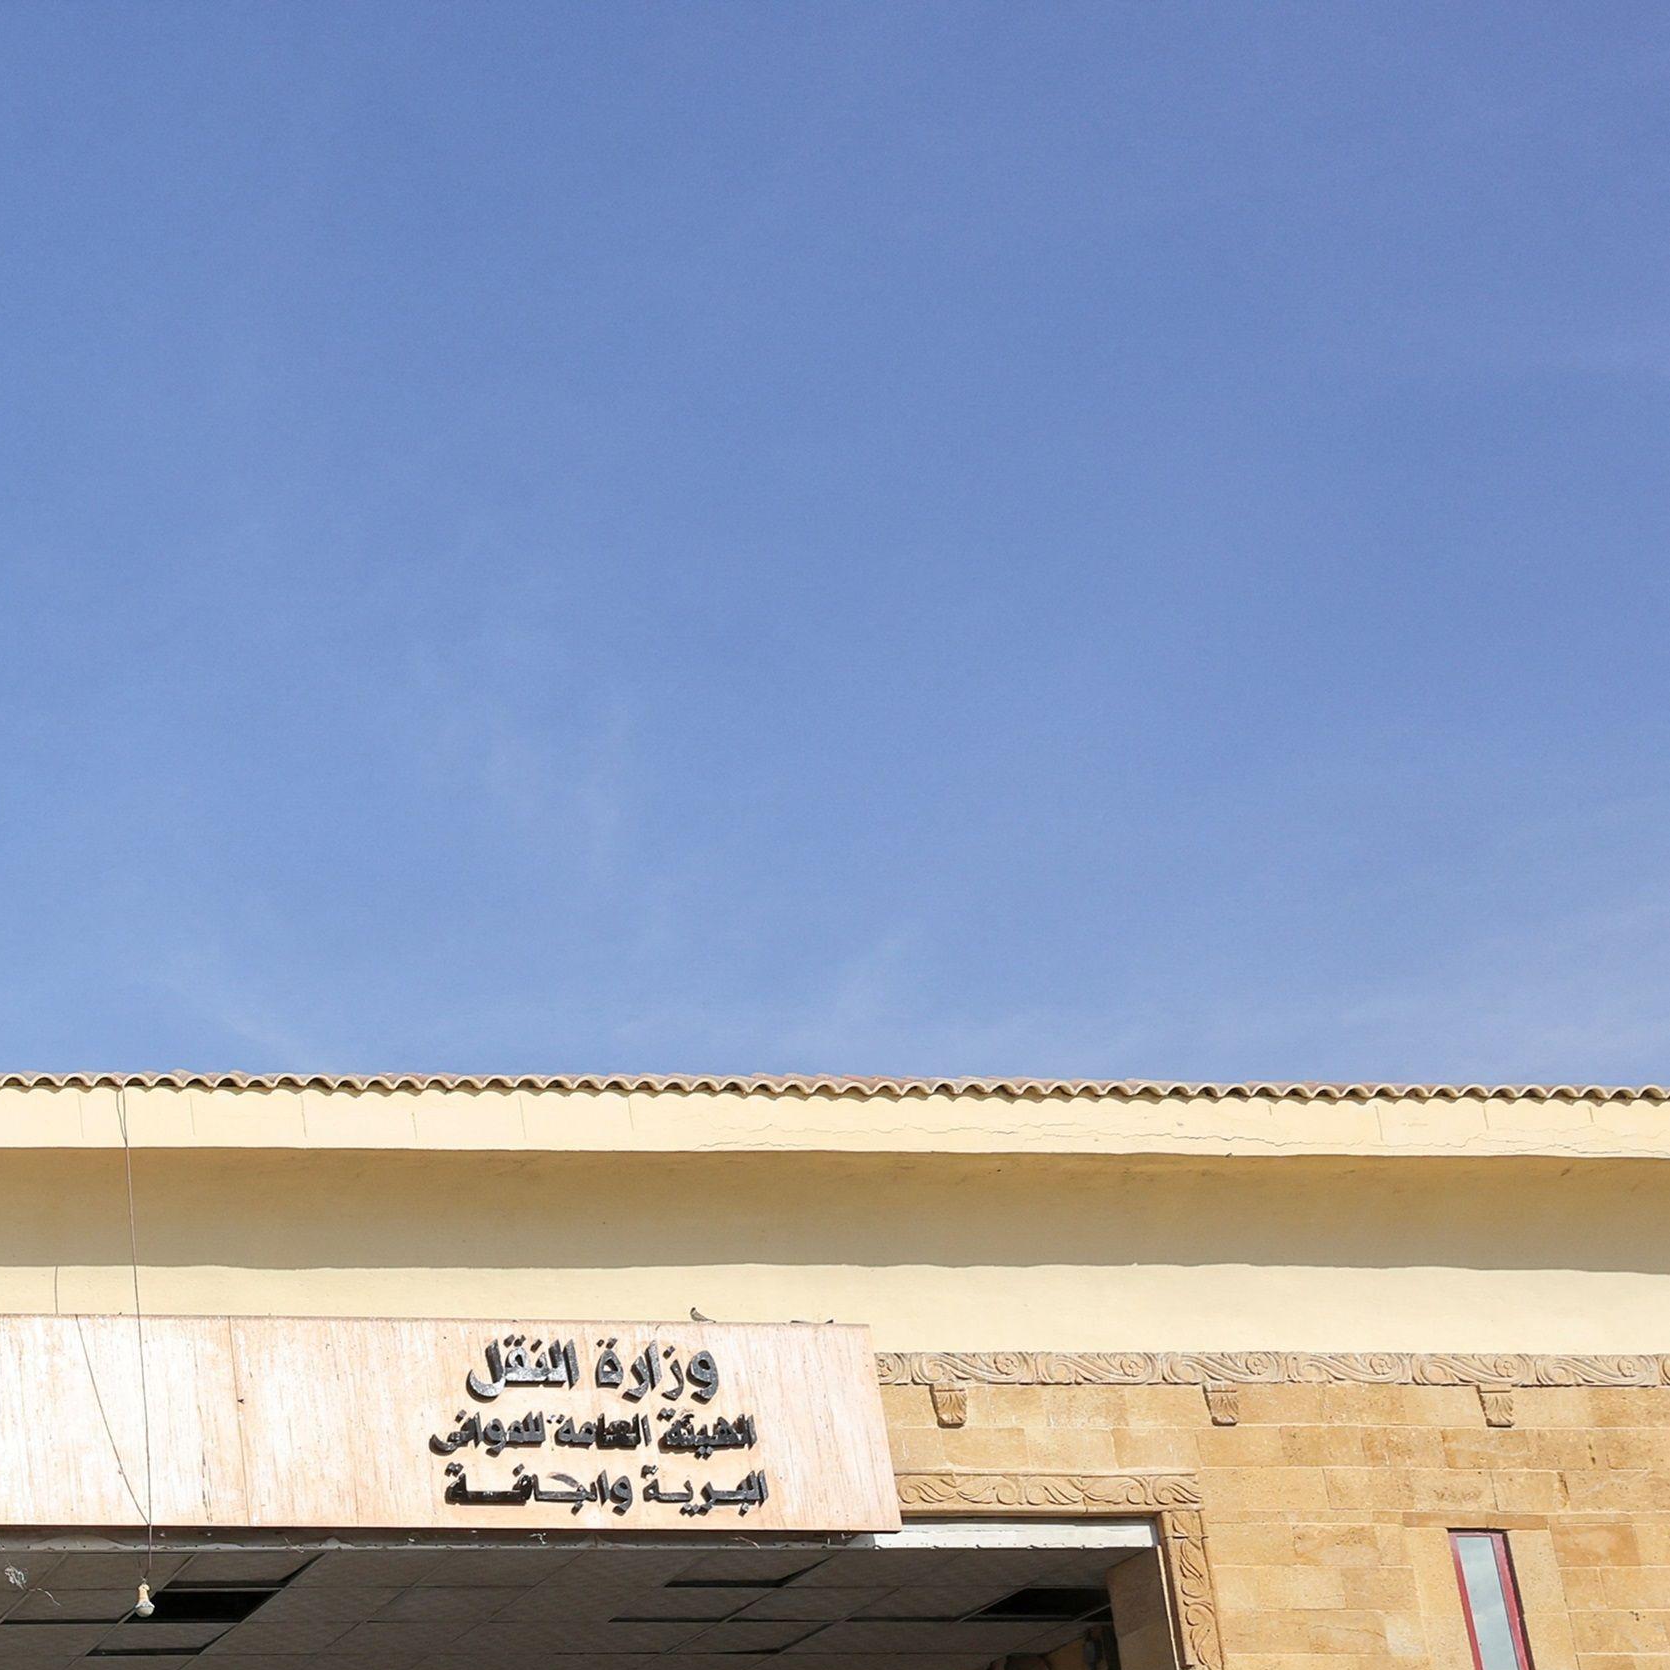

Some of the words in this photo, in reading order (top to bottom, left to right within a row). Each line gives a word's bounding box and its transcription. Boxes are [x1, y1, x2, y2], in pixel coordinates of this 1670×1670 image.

[466, 1334, 580, 1402] النقل
[596, 1336, 720, 1403] وزارة
[547, 1412, 653, 1450] العامة
[657, 1407, 758, 1460] الهيئة
[445, 1462, 633, 1516] والجافة
[641, 1464, 770, 1517] البرية
